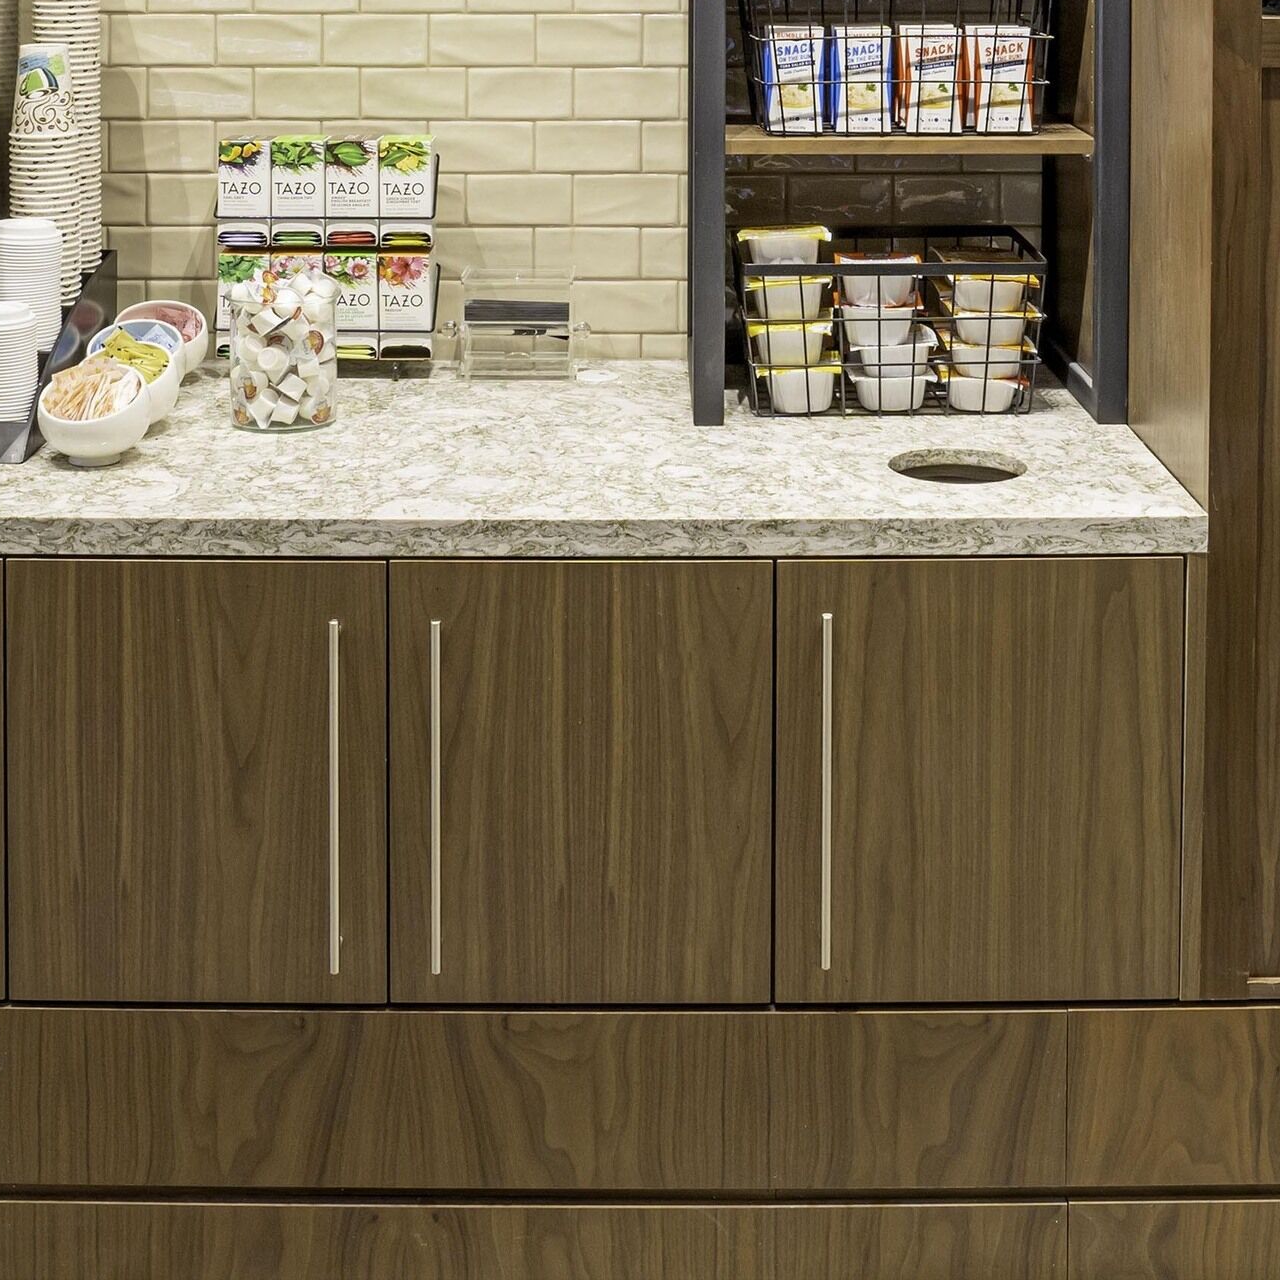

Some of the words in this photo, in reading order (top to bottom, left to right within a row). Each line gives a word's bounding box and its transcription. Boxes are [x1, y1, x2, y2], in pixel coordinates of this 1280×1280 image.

[915, 43, 954, 58] SNACK
[221, 181, 262, 195] TAZO
[275, 182, 316, 195] TAZO
[328, 181, 370, 195] TAZO
[383, 182, 425, 196] TAZO
[336, 293, 371, 307] AZO
[382, 294, 424, 308] TAZO
